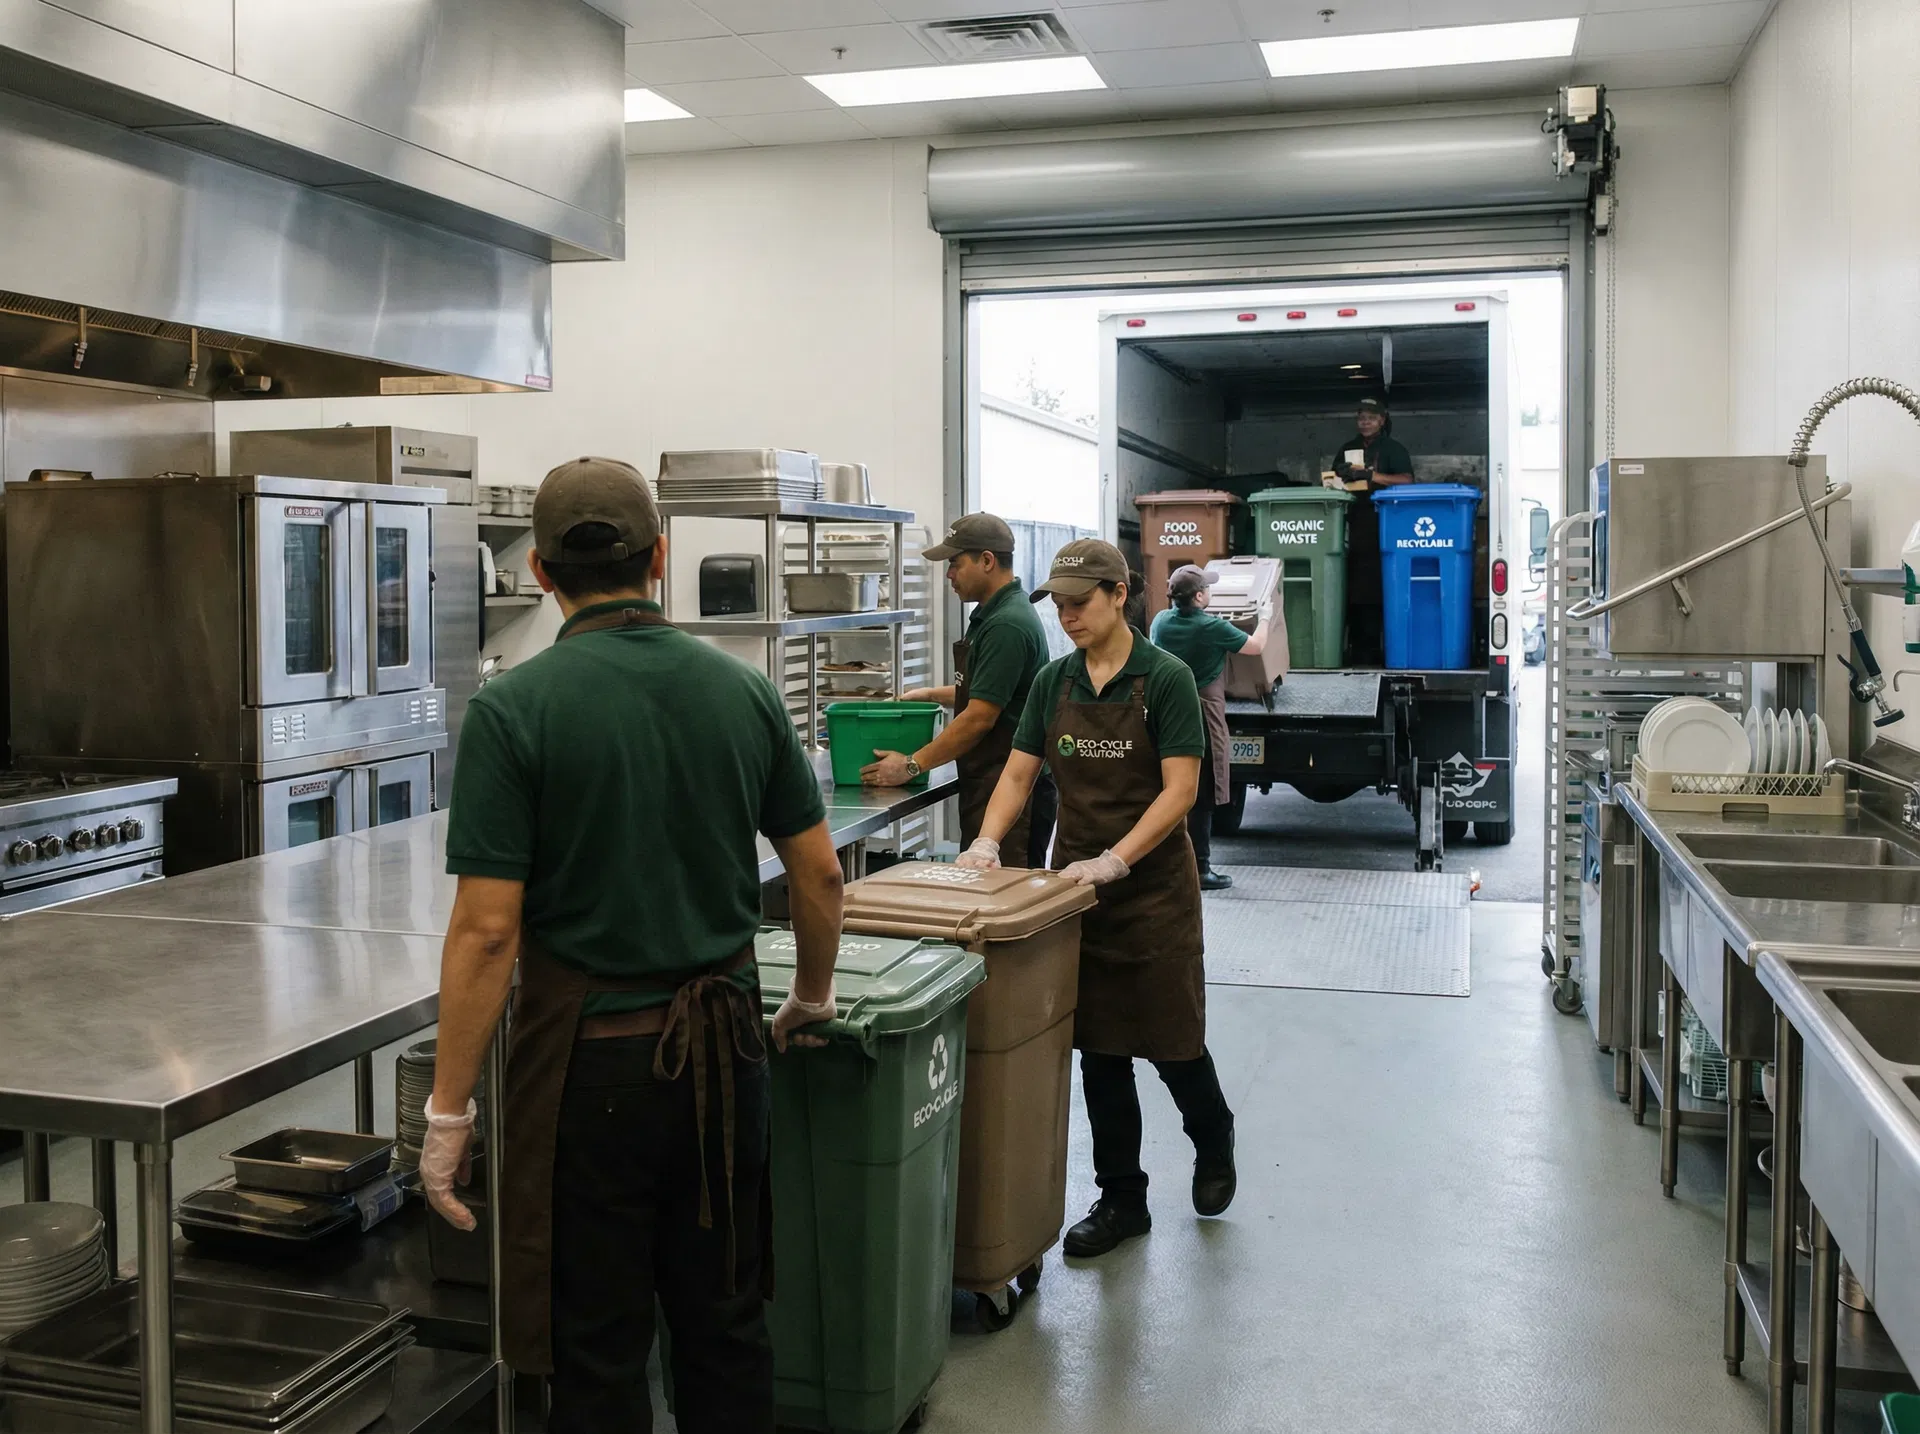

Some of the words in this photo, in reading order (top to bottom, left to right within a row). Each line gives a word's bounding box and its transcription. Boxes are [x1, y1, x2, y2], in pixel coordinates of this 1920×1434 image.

[1164, 522, 1197, 533] FOOD
[1270, 520, 1325, 532] ORGANIC
[1159, 535, 1202, 545] SCRAPS
[1278, 533, 1318, 545] WASTE
[1396, 539, 1454, 548] RECYCLABLE
[1076, 739, 1133, 750] ECO-CYCLE
